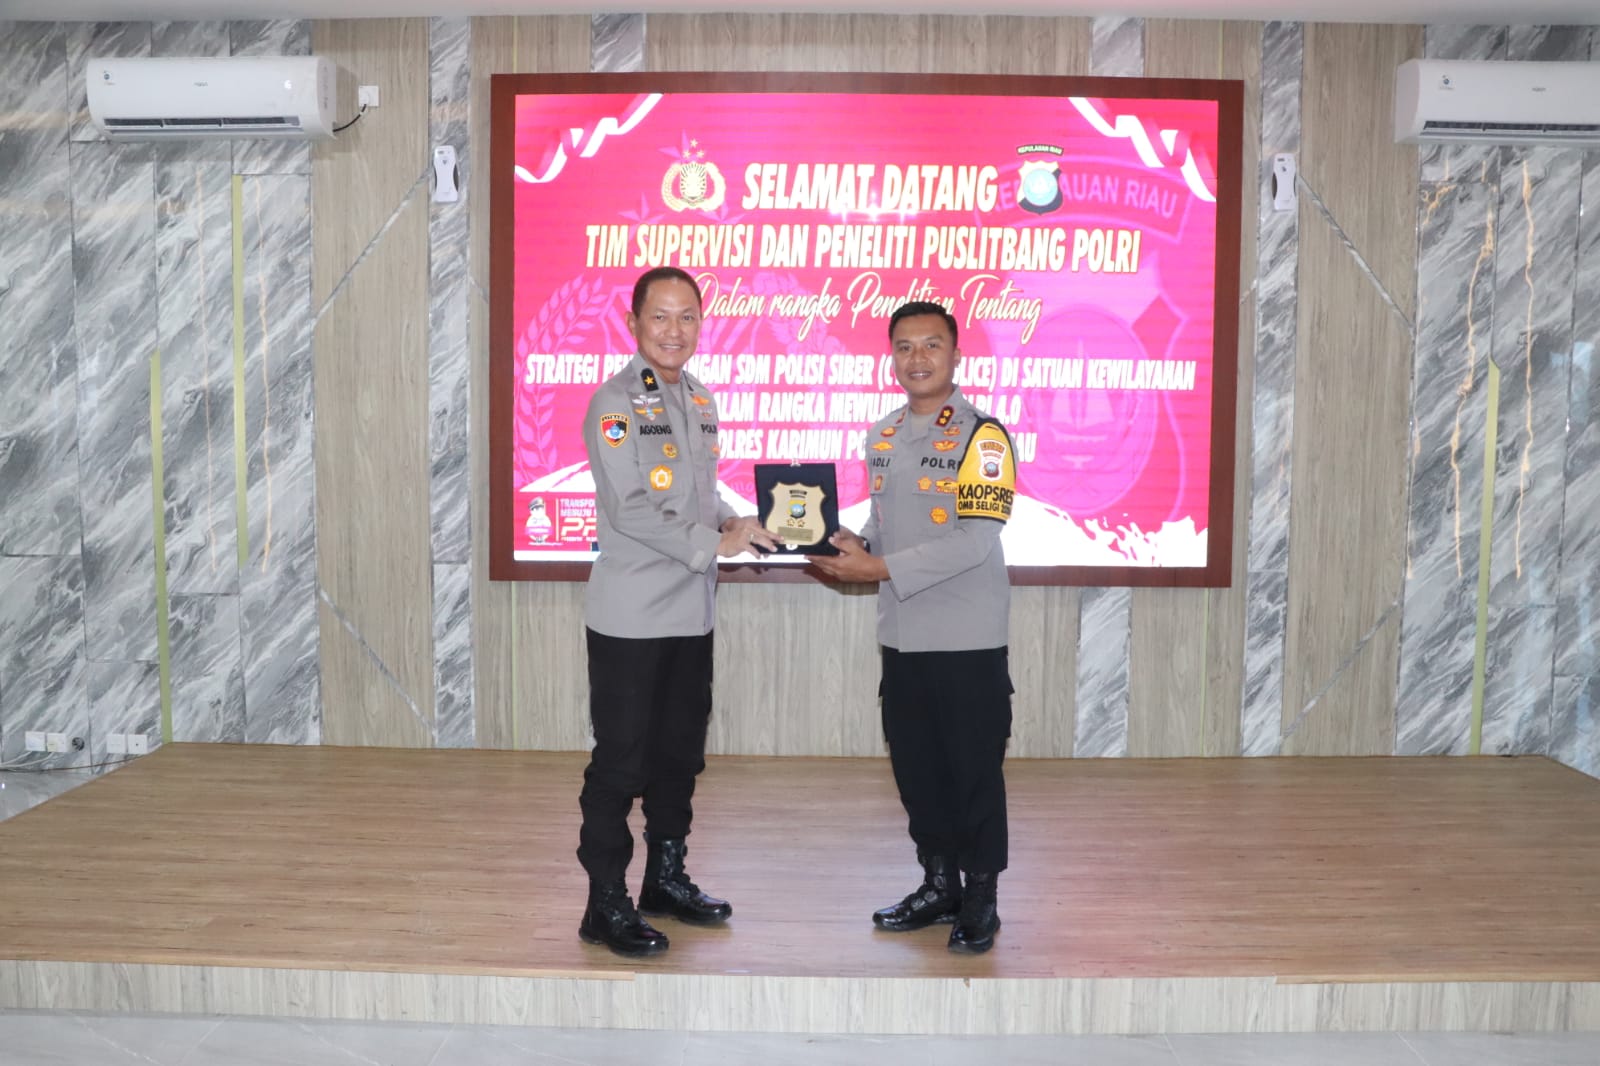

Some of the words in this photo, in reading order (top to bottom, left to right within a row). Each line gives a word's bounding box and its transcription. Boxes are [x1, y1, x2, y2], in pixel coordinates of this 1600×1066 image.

[742, 162, 875, 210] SELAMAT
[881, 164, 999, 213] DATANG
[1124, 179, 1177, 219] RIAU
[586, 224, 628, 268] TIM
[634, 223, 754, 268] SUPERVISI
[759, 224, 809, 268] DAN
[814, 224, 917, 269] PENELITI
[922, 225, 1066, 271] PUSLITBANG
[1072, 227, 1142, 273] POLRI
[694, 271, 765, 320] Dalam
[769, 276, 842, 342] rangka
[960, 273, 1042, 345] Tentang
[525, 353, 601, 385] STRATEGI
[734, 354, 771, 385] SDM
[773, 354, 826, 386] POLISI
[828, 354, 875, 386] SIBER
[952, 355, 998, 392] OLICE)
[1000, 357, 1019, 388] DI
[1021, 357, 1085, 389] SATUAN
[1086, 358, 1197, 391] KEWILAYAHAN
[714, 391, 755, 423] ALAM
[758, 391, 826, 423] RANGKA
[829, 391, 909, 424] MEWUJU
[995, 393, 1022, 426] 4.0
[639, 424, 672, 436] AGOENG
[718, 428, 764, 460] OLRES
[766, 429, 844, 460] KARIMUN
[958, 483, 1014, 506] KAOPSRES
[975, 500, 1000, 513] SELIGI
